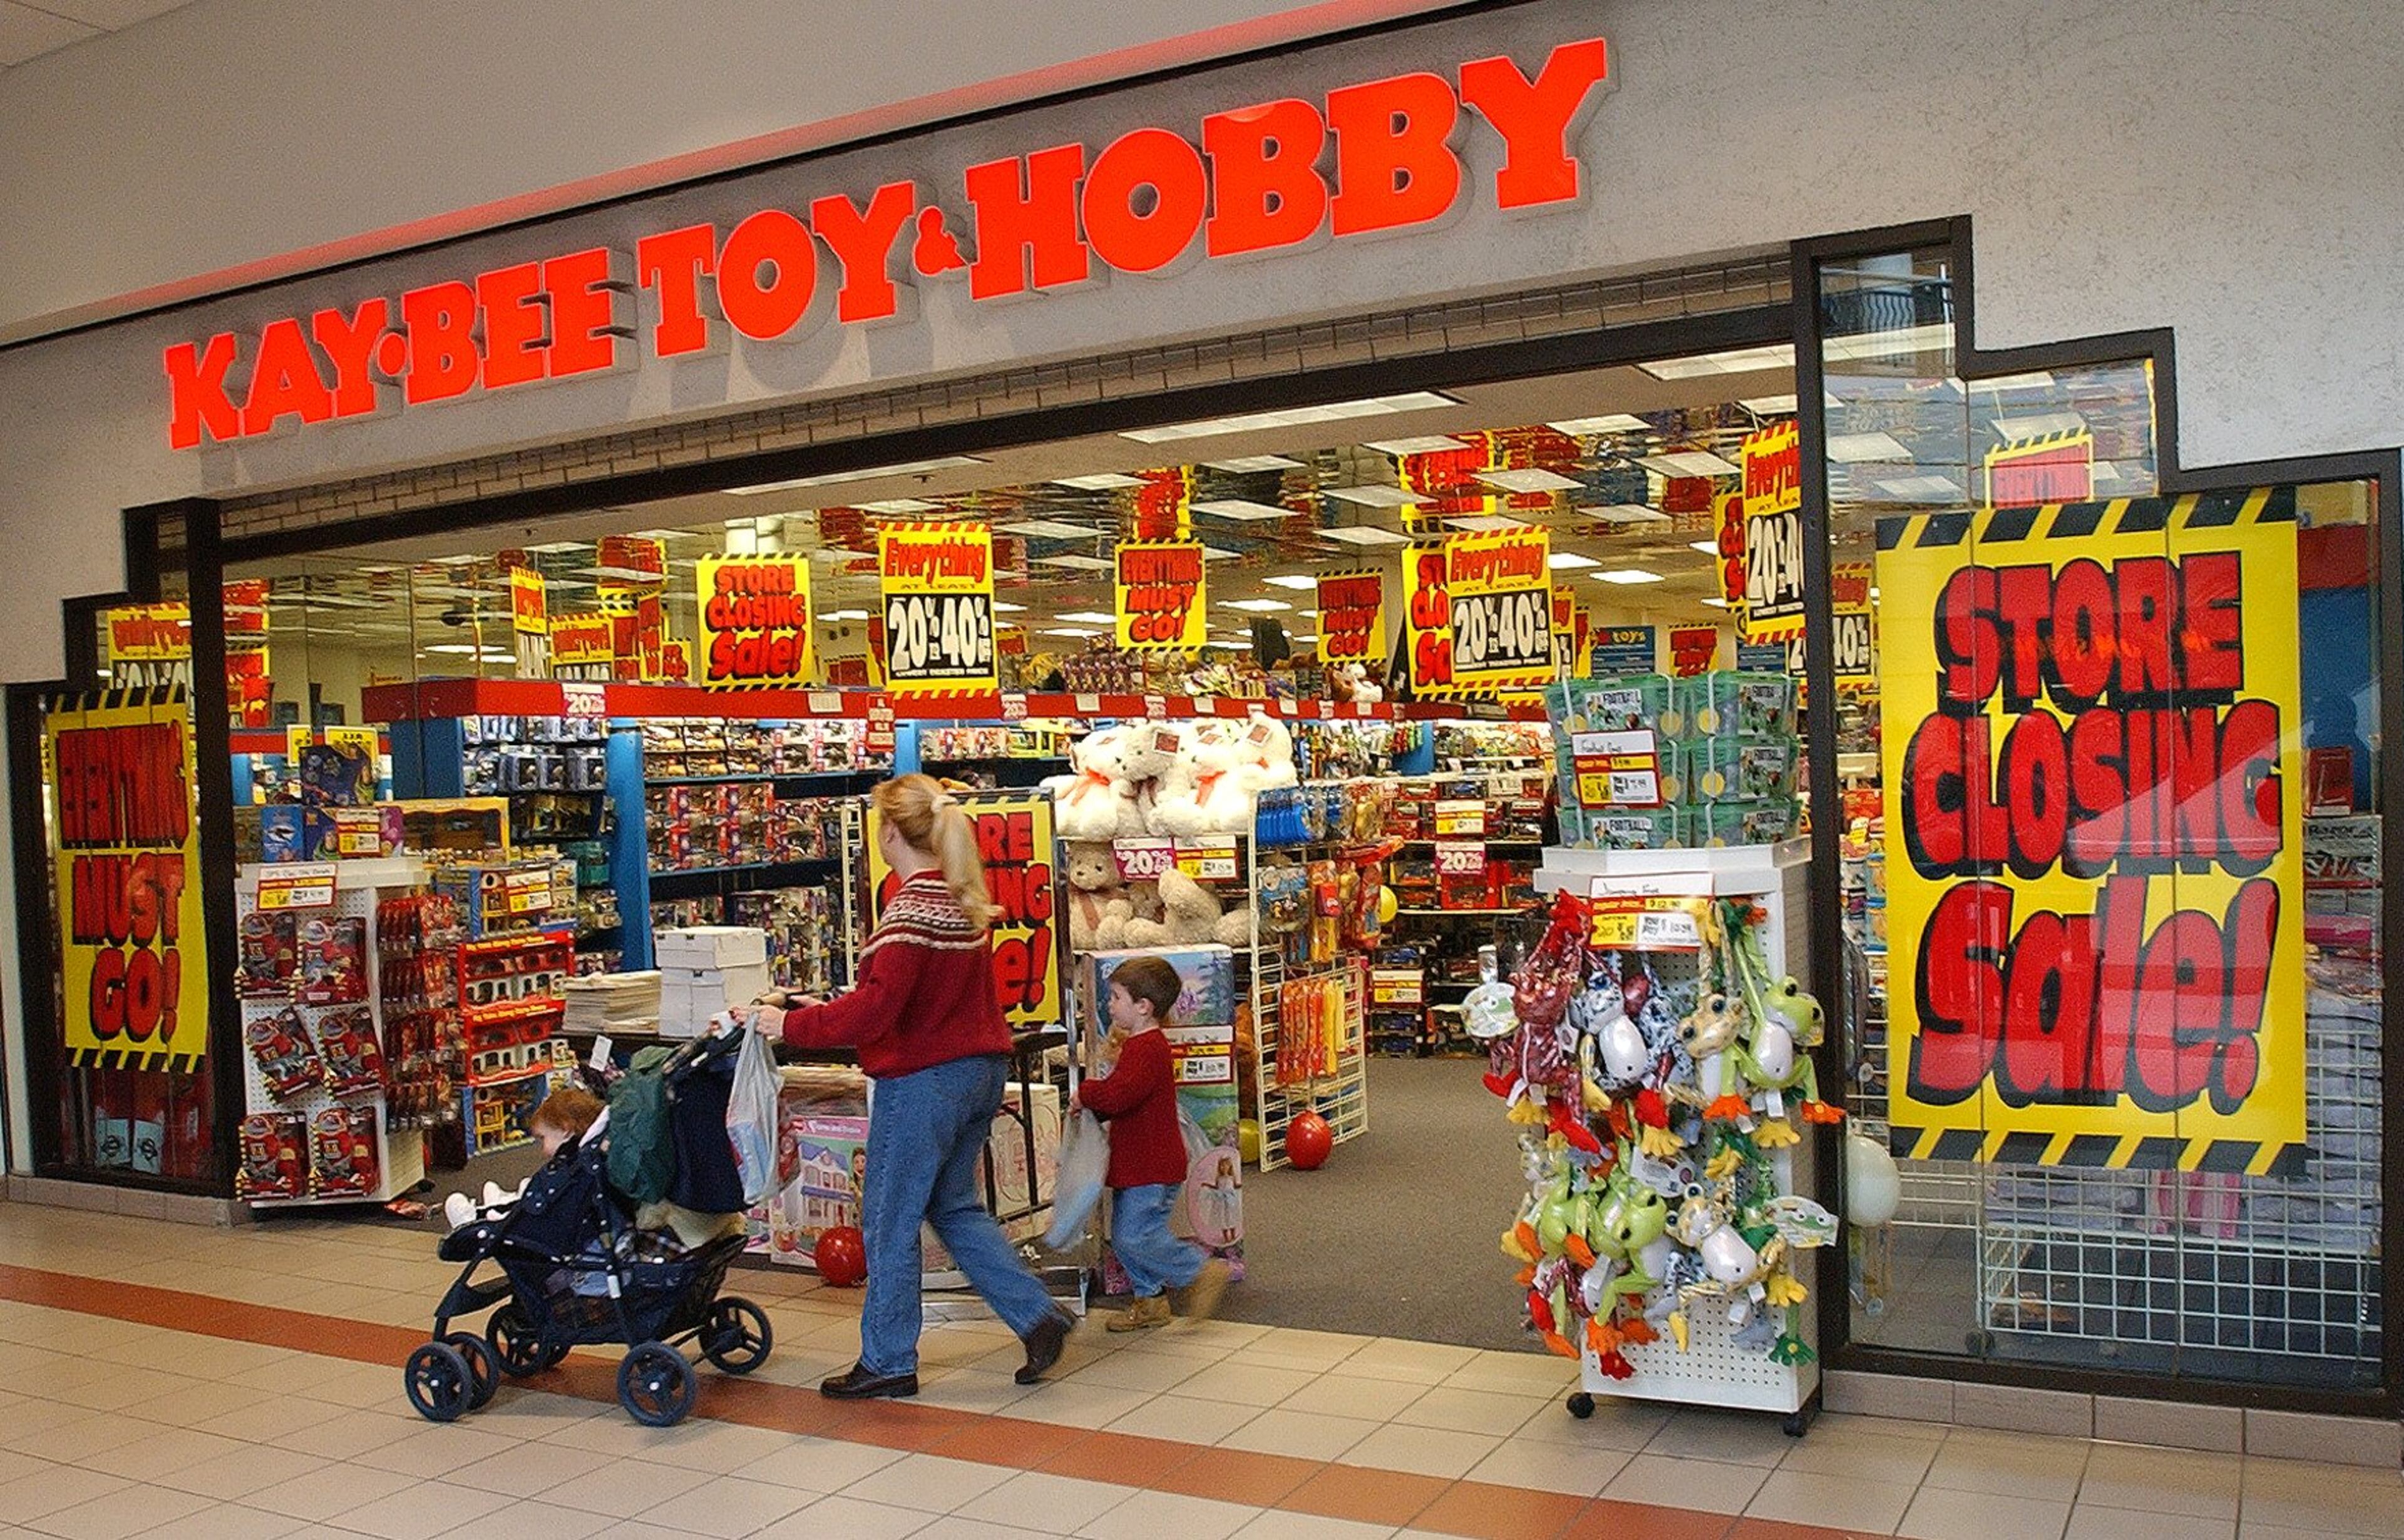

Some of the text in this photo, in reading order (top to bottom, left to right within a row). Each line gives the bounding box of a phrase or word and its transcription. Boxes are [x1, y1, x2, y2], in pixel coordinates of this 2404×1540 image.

[637, 181, 915, 357] TOY
[913, 205, 970, 277] &
[965, 38, 1606, 301] HOBBY
[714, 564, 796, 597] STORE
[885, 536, 987, 584] Everything
[705, 593, 806, 633] CLOSING
[1124, 584, 1197, 615] MUST
[707, 627, 806, 681] Sale!
[1129, 612, 1186, 643] GO!
[1612, 630, 1646, 644] toys
[1935, 550, 2244, 715] STORE
[1901, 699, 2283, 880] CLOSING
[72, 852, 185, 948] MUST
[90, 947, 181, 1044] GO!
[1906, 875, 2280, 1116] Sale!
